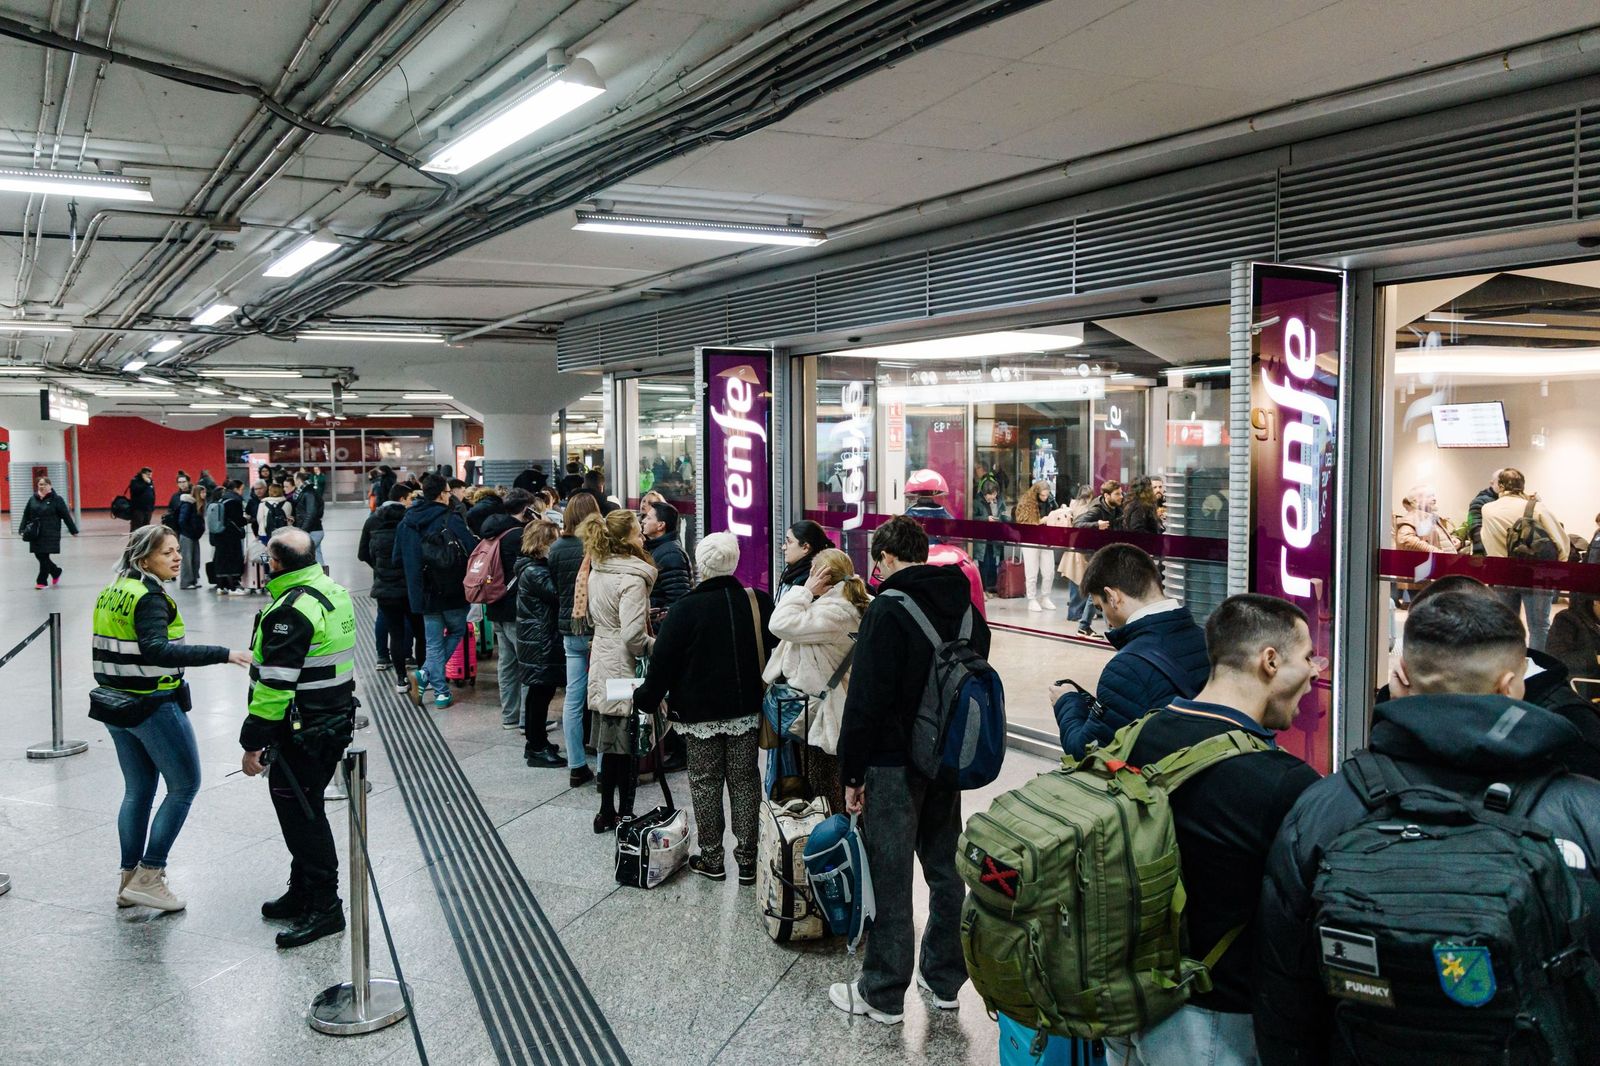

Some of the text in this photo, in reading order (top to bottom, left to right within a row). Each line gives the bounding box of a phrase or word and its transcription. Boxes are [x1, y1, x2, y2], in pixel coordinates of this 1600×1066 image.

[710, 376, 767, 537] renfe
[1262, 316, 1332, 598] renfe
[1345, 980, 1389, 998] PUMUKY
